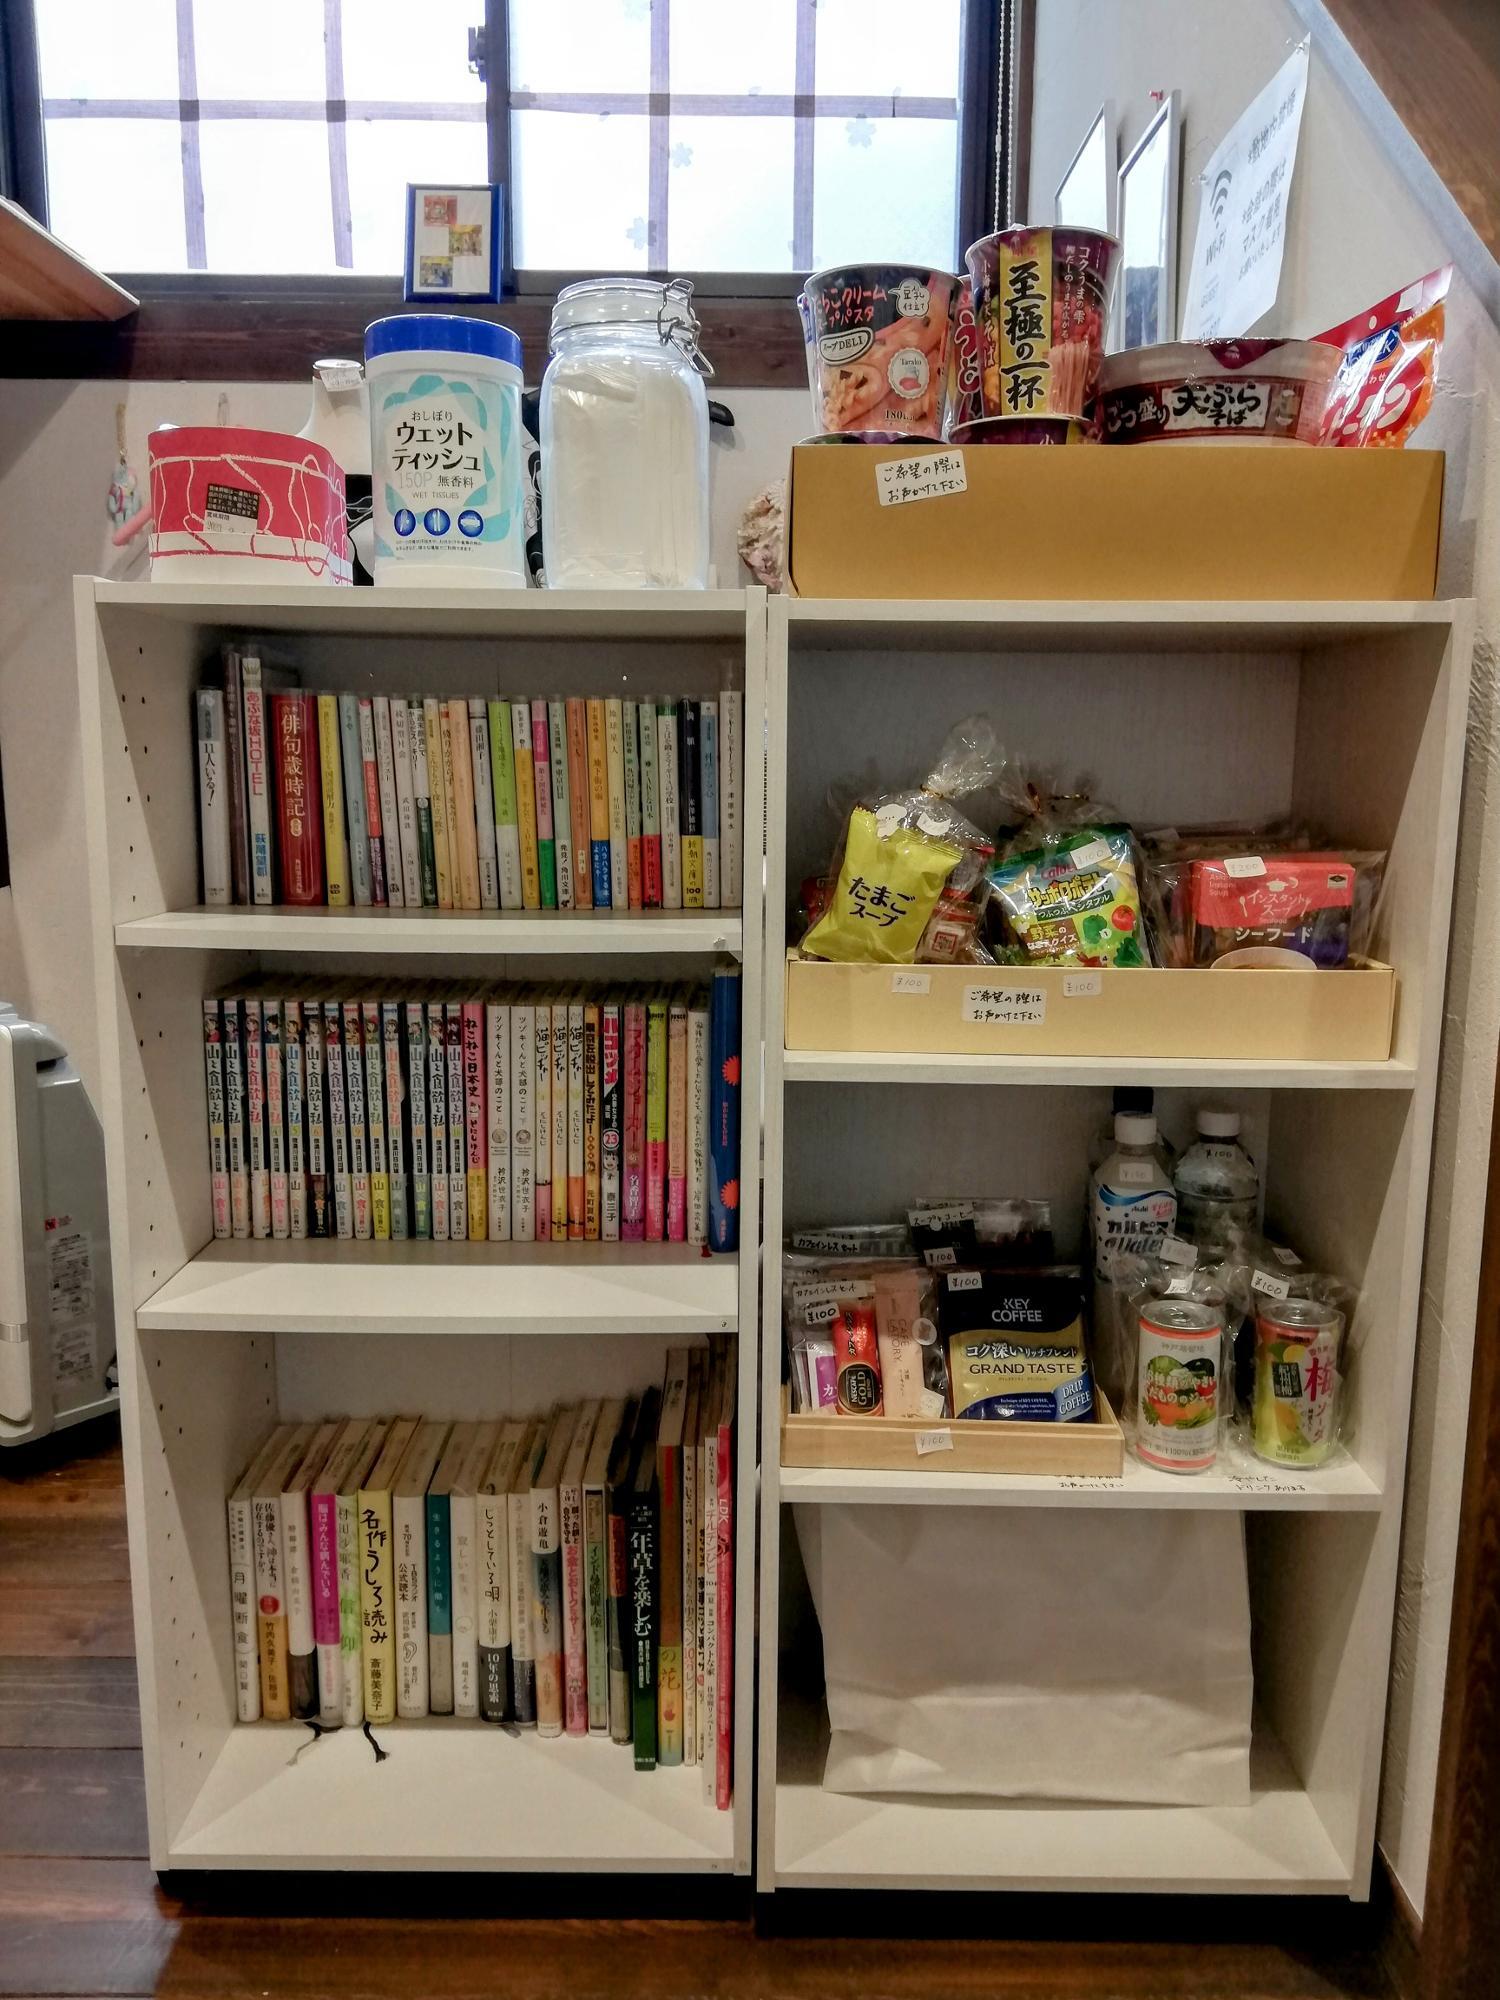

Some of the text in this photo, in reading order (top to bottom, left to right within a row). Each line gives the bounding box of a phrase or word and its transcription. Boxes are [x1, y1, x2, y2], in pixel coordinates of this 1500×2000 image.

[904, 286, 925, 300] 豆乳
[1073, 246, 1091, 325] コクうまの雫
[903, 302, 925, 312] 仕立て
[1000, 260, 1051, 411] 至極の一杯
[1172, 383, 1261, 417] 天ぷら
[411, 410, 454, 422] おしぼり
[1106, 397, 1170, 433] ごつ盛り
[1207, 407, 1249, 427] そば
[396, 422, 474, 446] ウェット
[391, 447, 482, 473] ティッシュ
[883, 456, 961, 483] ご希望の際は
[411, 490, 461, 501] WET TISSUES
[437, 475, 474, 490] 無香料
[281, 714, 306, 817] 俳句歳時記
[686, 886, 702, 894] 100
[848, 876, 916, 916] たまご
[1026, 871, 1106, 908] サッポロポテト
[1247, 889, 1306, 906] インスタント
[849, 902, 899, 927] スープ
[1262, 903, 1293, 918] スープ
[1030, 921, 1067, 941] 野菜の
[1234, 926, 1313, 944] シーフード
[969, 990, 1043, 1005] ご希望の際は
[463, 1017, 481, 1098] ねこねこ日本史
[208, 1045, 223, 1125] 山と食欲と私
[226, 1045, 241, 1125] 山と食欲と私
[248, 1045, 261, 1124] 山と食欲と私
[267, 1045, 281, 1124] 山と食欲と私
[288, 1045, 301, 1125] 山と食欲と私
[308, 1047, 322, 1126] 山と食欲と私
[329, 1047, 345, 1126] 山と食欲と私
[348, 1047, 364, 1126] 山と食欲と私
[367, 1047, 382, 1126] 山と食欲と私
[387, 1047, 401, 1127] 山と食欲と私
[411, 1047, 425, 1126] 山と食欲と私
[432, 1048, 444, 1128] 山と食欲と私
[450, 1047, 463, 1126] 山と食欲と私
[605, 1133, 618, 1145] 23
[798, 1238, 858, 1252] カフェインレス セット
[951, 1277, 979, 1288] ¥100
[1254, 1277, 1282, 1296] ¥100
[807, 1307, 837, 1322] ¥100
[991, 1310, 1043, 1322] COFFEE
[1003, 1298, 1031, 1310] KEY
[966, 1342, 1077, 1361] コク深い リッチブレンド
[969, 1363, 1078, 1377] GRAND TASTE
[1303, 1356, 1335, 1402] 梅
[858, 1371, 867, 1405] GOLD
[1062, 1379, 1084, 1399] DRIP
[1059, 1391, 1091, 1415] COFFEE
[719, 1499, 729, 1524] LDK
[317, 1503, 331, 1598] 脳はみんな病んでいる
[359, 1508, 388, 1645] 名作うしろ読み
